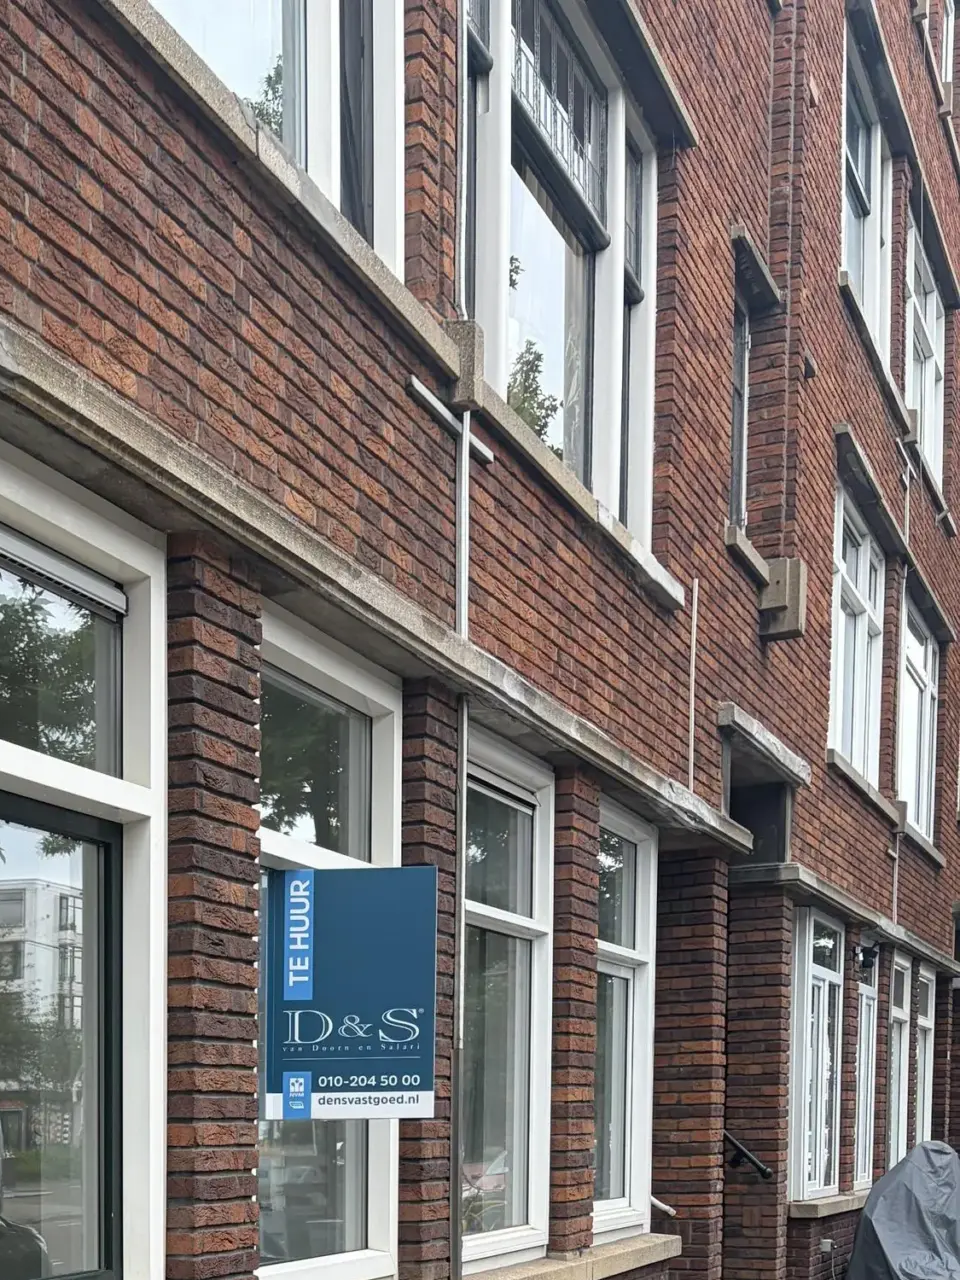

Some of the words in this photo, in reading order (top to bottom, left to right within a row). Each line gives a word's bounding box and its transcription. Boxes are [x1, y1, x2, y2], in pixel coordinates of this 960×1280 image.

[289, 880, 310, 949] HUUR
[288, 957, 309, 987] TE
[312, 1044, 350, 1052] Doorn
[380, 1043, 420, 1051] Salari
[318, 1075, 376, 1087] 010-204
[380, 1075, 398, 1086] 50
[401, 1074, 420, 1086] 00
[318, 1094, 419, 1106] densvastgoed.nl
